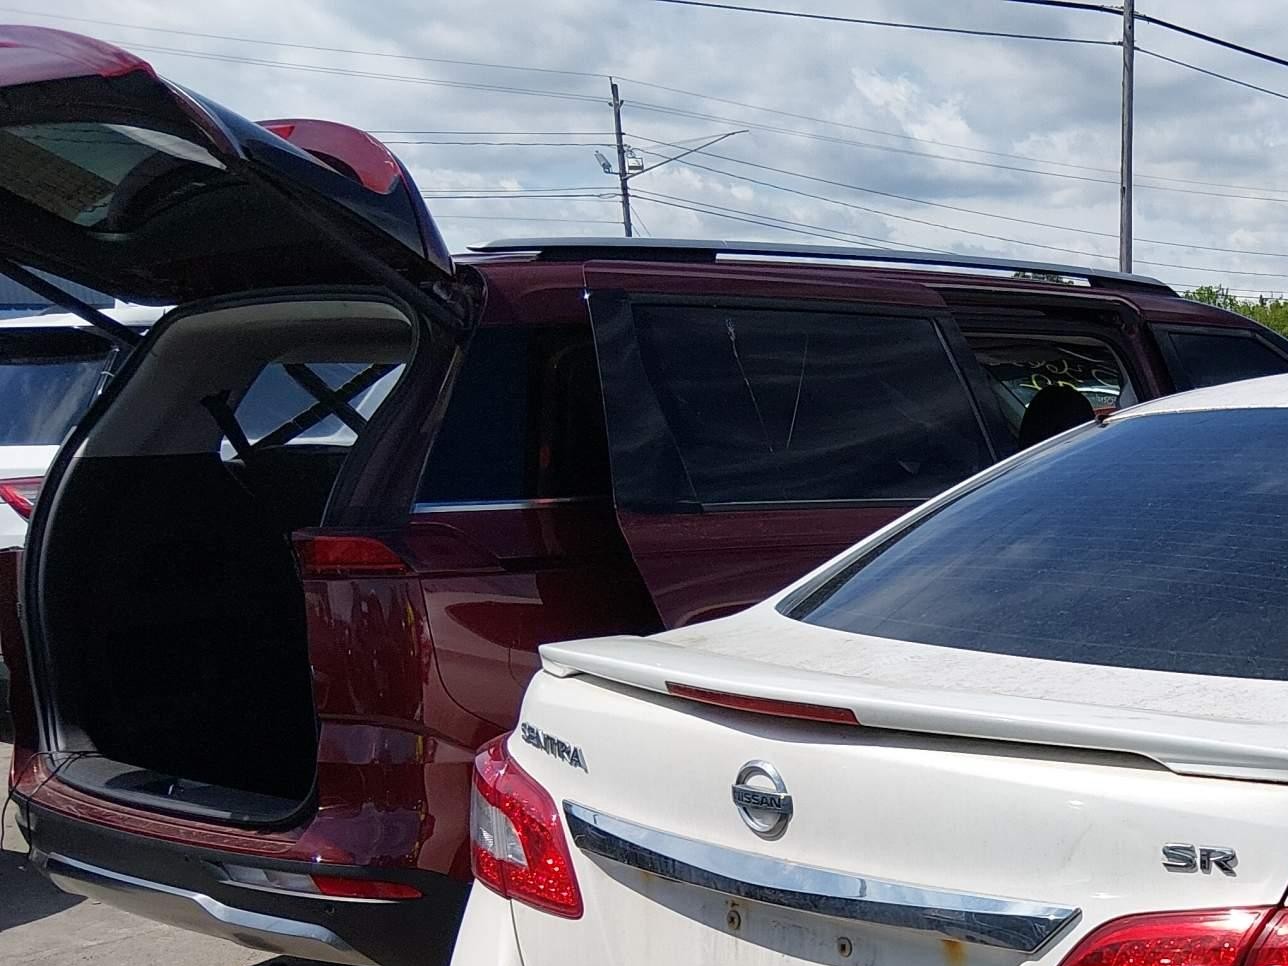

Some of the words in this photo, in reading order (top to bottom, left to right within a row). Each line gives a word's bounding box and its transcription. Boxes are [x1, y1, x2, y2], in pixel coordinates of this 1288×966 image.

[521, 722, 588, 774] SENTRA
[736, 790, 782, 809] NISSAN
[1162, 842, 1239, 877] SR
